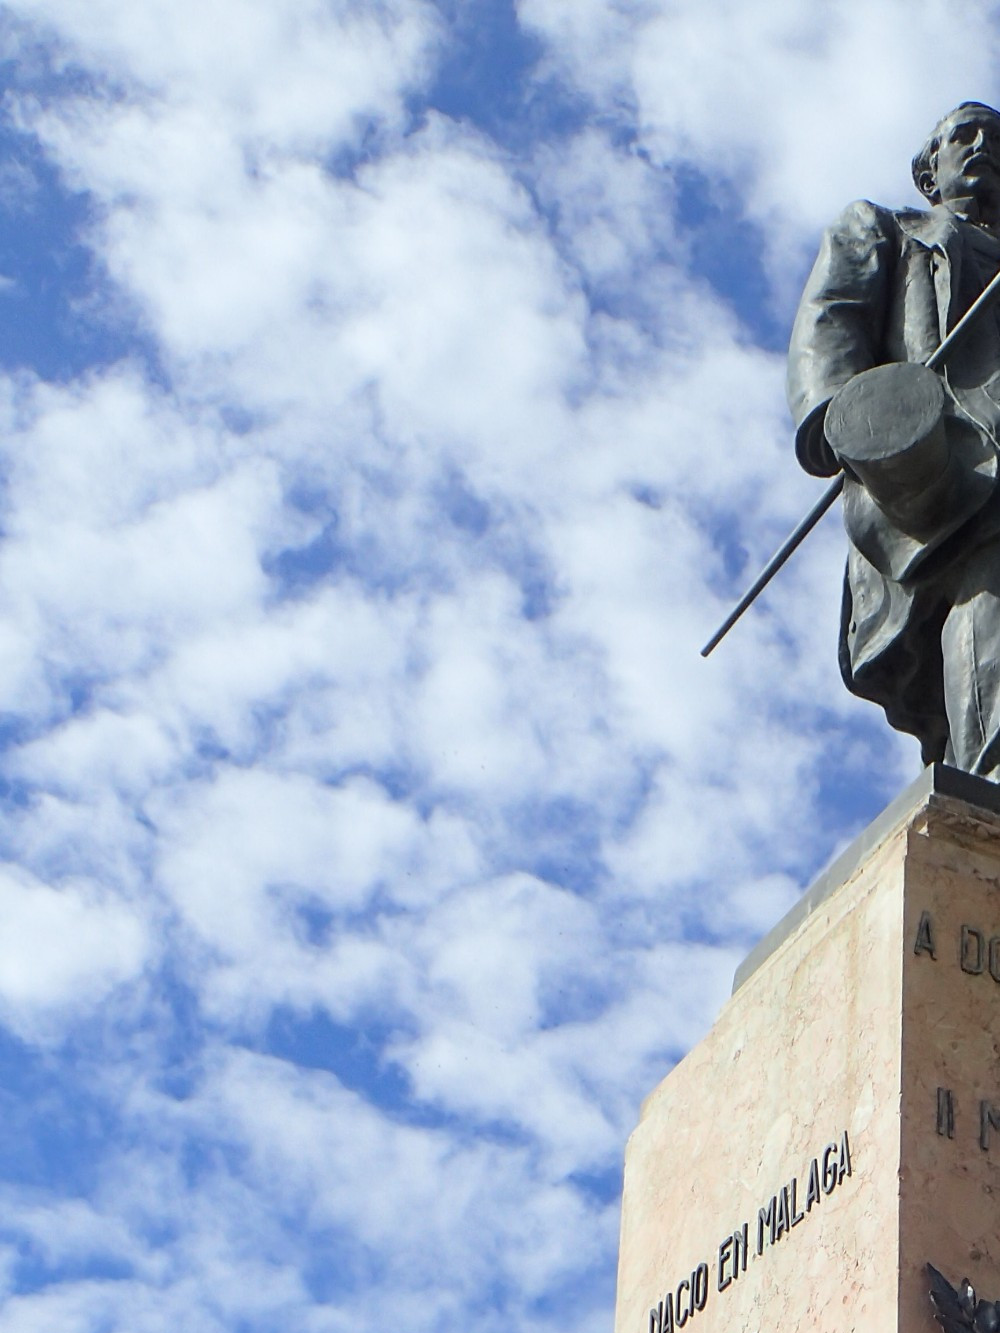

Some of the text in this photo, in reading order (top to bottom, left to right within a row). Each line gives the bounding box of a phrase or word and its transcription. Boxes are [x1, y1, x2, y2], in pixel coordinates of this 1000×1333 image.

[914, 911, 937, 960] A
[718, 1223, 748, 1292] EN
[757, 1130, 852, 1255] MALAGA
